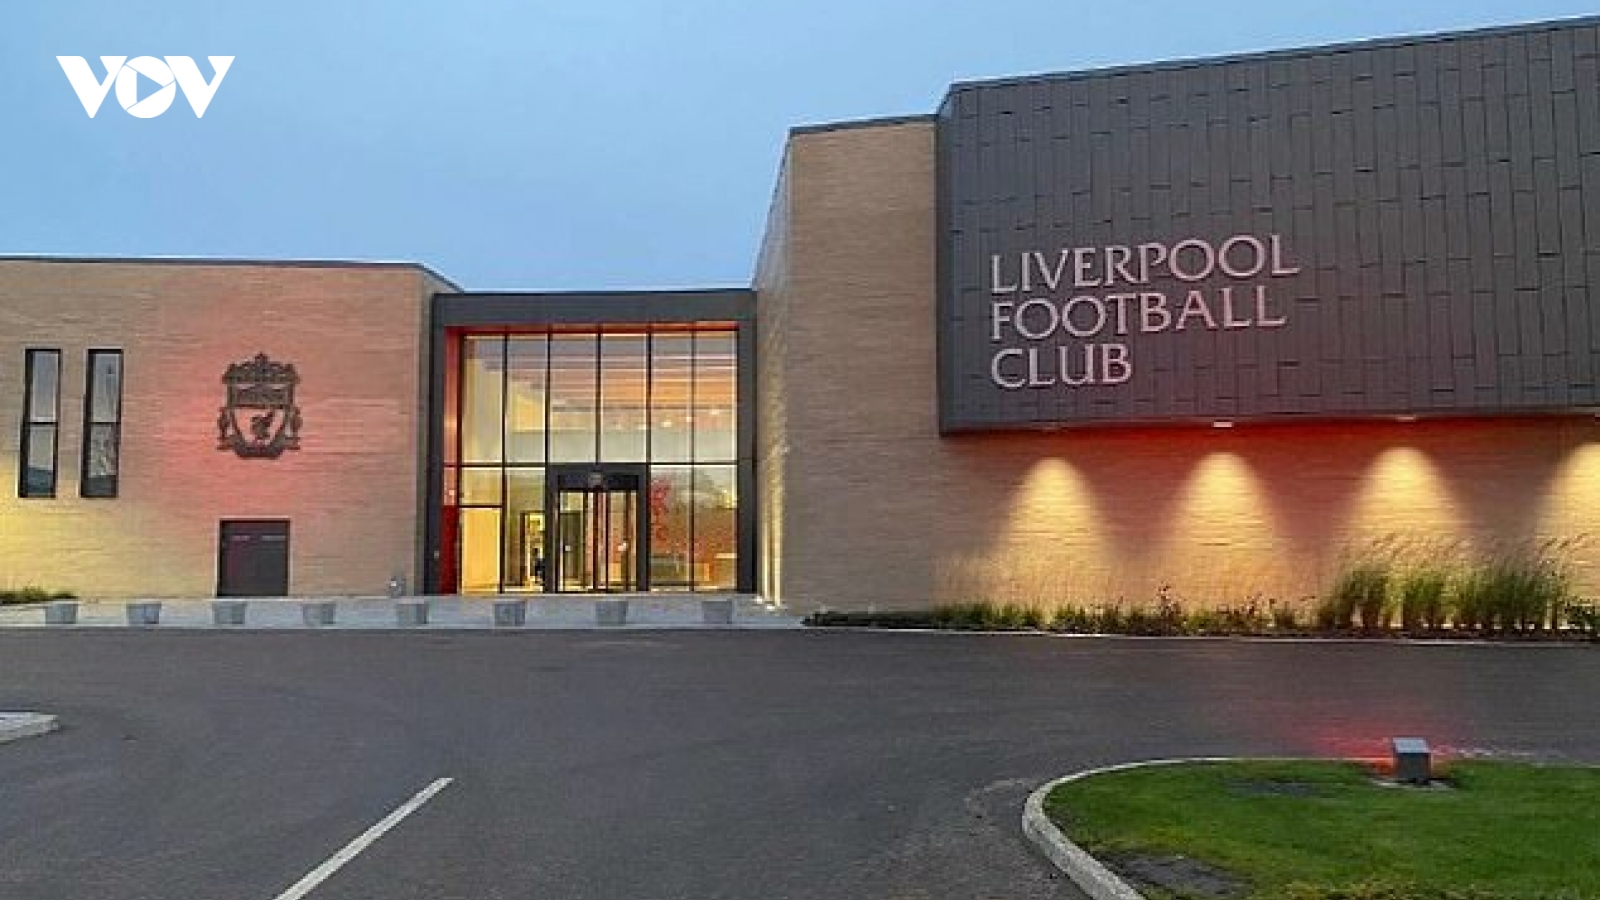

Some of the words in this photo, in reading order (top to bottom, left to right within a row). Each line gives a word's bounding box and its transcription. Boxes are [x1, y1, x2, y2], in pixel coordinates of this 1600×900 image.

[990, 234, 1300, 294] LIVERPOOL
[990, 285, 1288, 340] FOOTBALL
[991, 343, 1133, 389] CLUB
